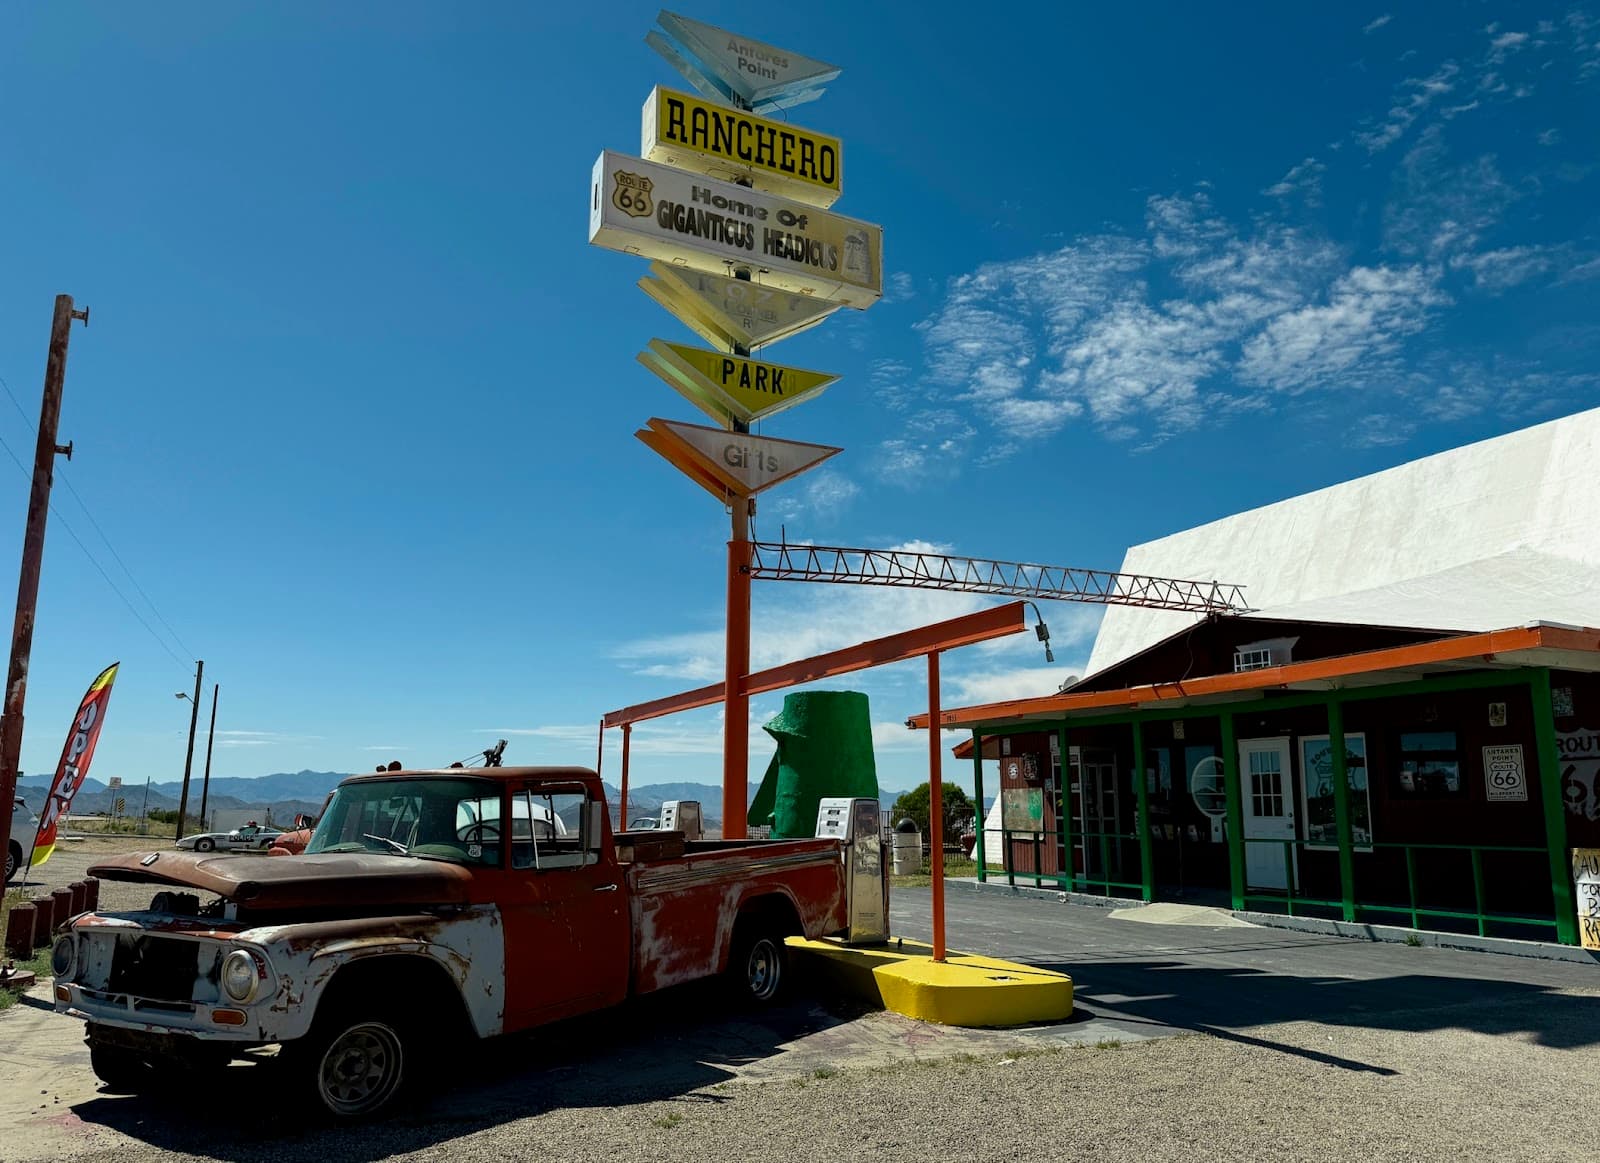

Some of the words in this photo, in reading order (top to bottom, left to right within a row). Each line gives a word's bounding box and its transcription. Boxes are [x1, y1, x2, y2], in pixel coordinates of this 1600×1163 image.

[738, 56, 777, 80] Point
[666, 97, 836, 184] RANCHERO
[619, 187, 647, 212] 66
[691, 185, 769, 221] Home
[775, 209, 808, 231] Of
[656, 199, 755, 251] GIGANTICUS
[763, 227, 838, 272] HEADICUS
[722, 358, 784, 396] PARK
[724, 444, 778, 473] Gits
[1494, 772, 1516, 786] 66
[1561, 764, 1600, 803] 6
[229, 834, 255, 842] POLICE
